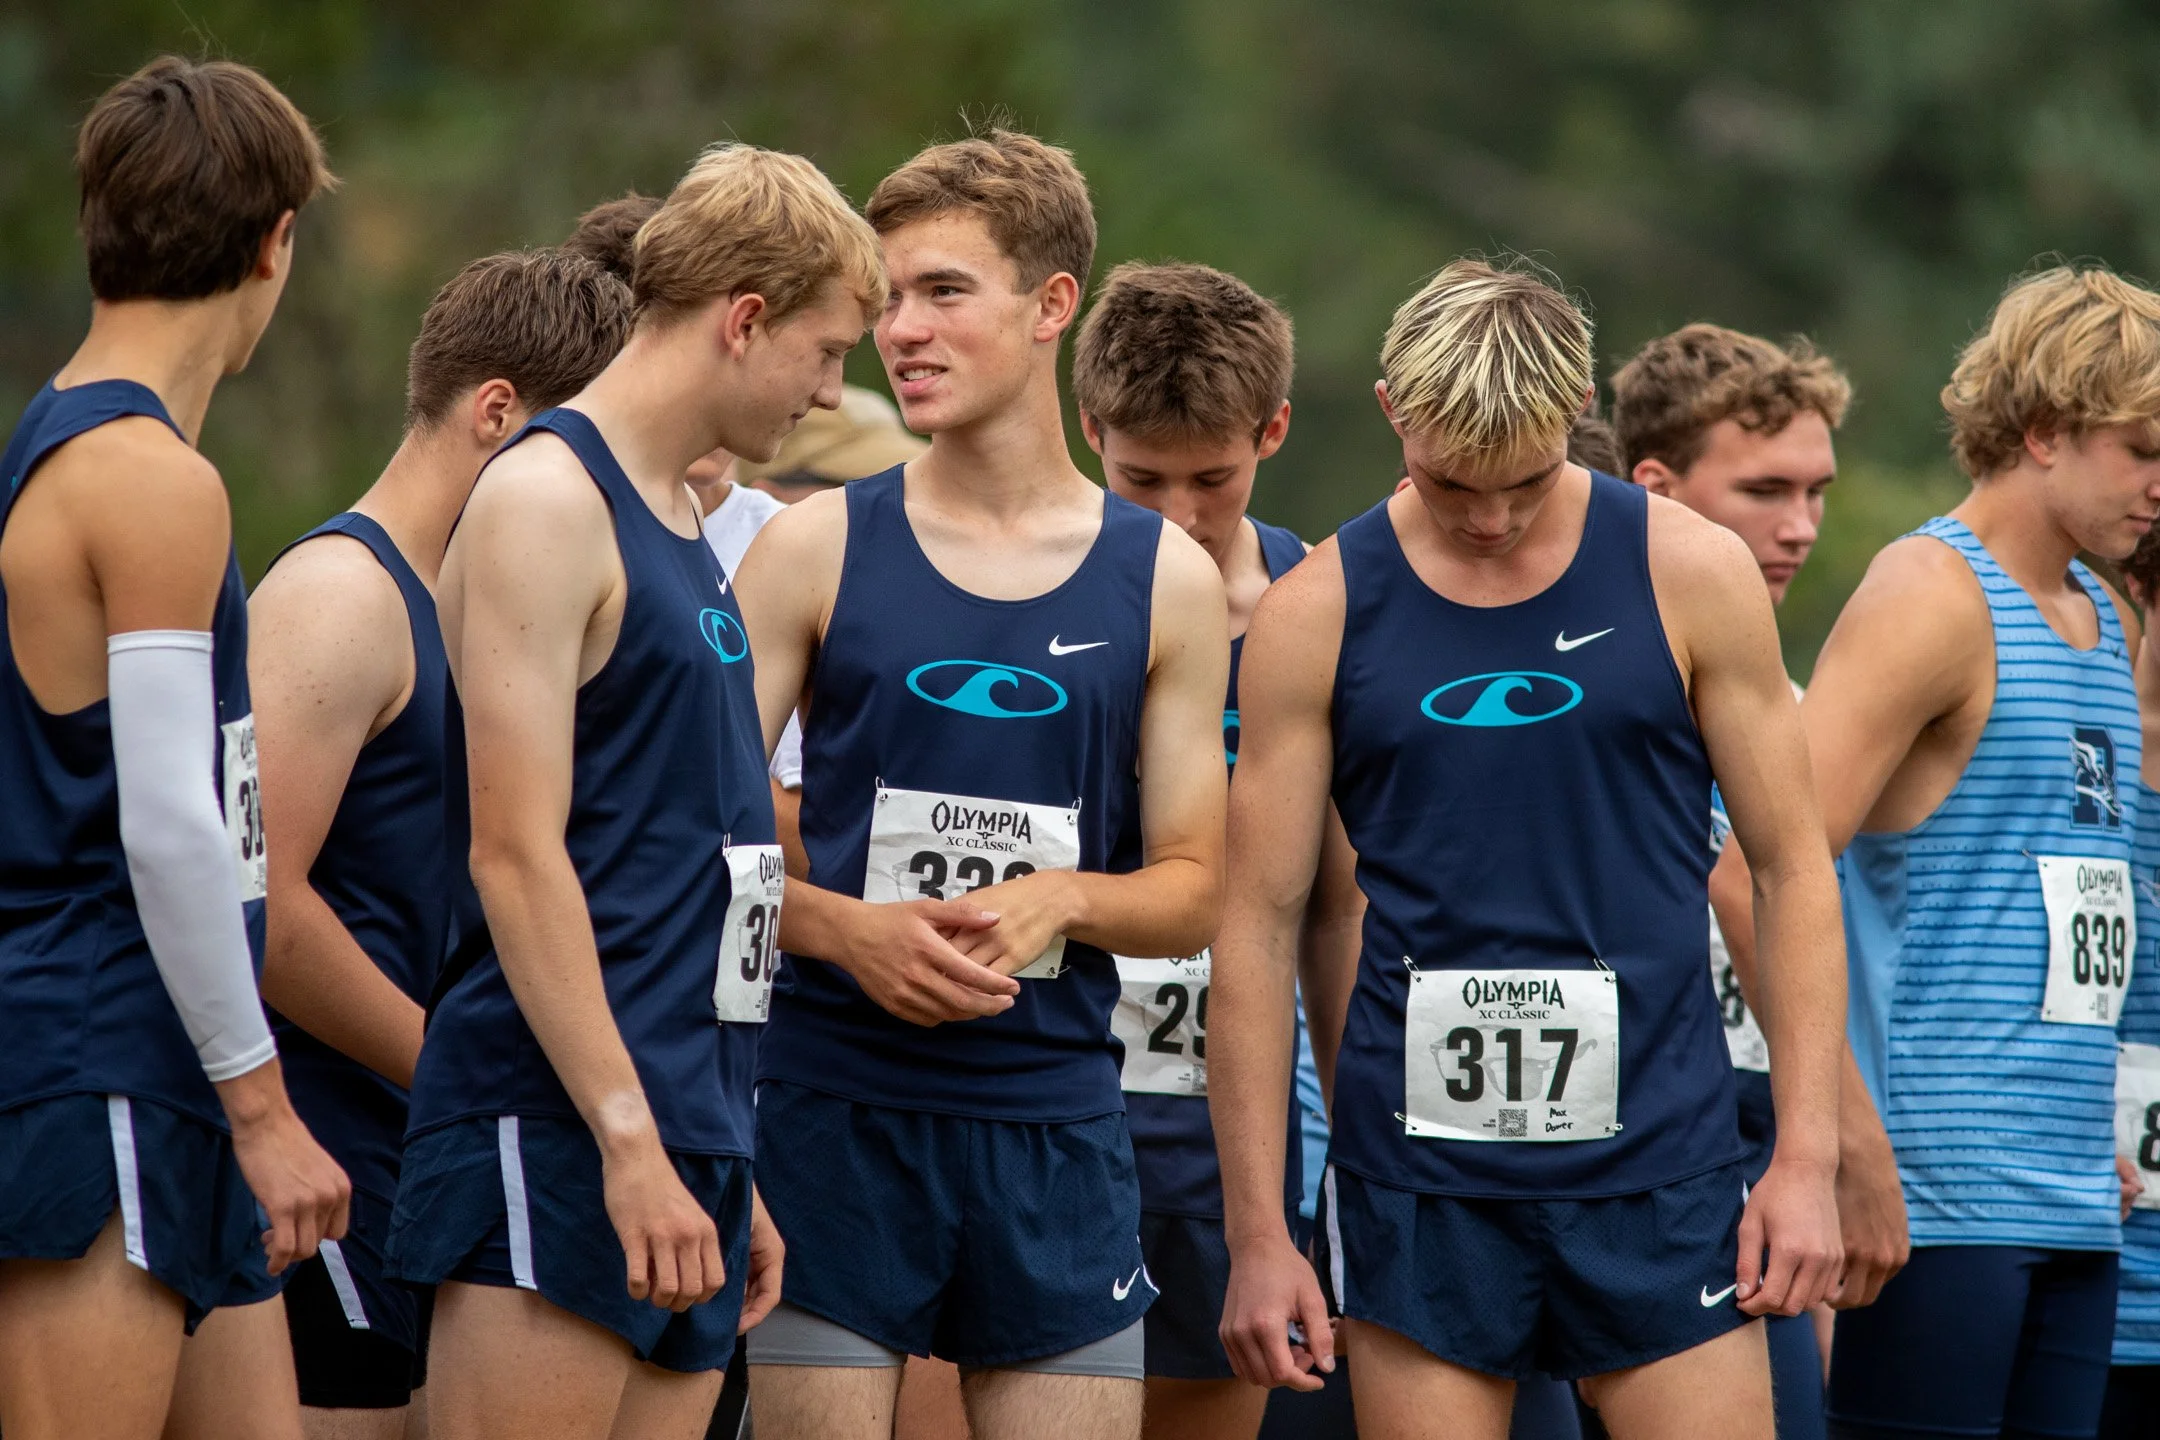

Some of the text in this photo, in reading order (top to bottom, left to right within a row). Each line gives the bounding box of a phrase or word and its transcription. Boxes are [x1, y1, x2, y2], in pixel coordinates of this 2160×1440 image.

[931, 800, 1032, 844] OLYMPIA
[946, 836, 1017, 853] XC CLASSIC
[908, 850, 1036, 901] 33
[2077, 864, 2123, 896] OLYMPIA
[2071, 912, 2126, 988] 839
[1184, 967, 1200, 977] XC
[1462, 976, 1565, 1010] OLYMPIA
[1479, 1010, 1550, 1020] XC CLASSIC
[1446, 1026, 1578, 1102] 317
[1549, 1107, 1567, 1118] Max
